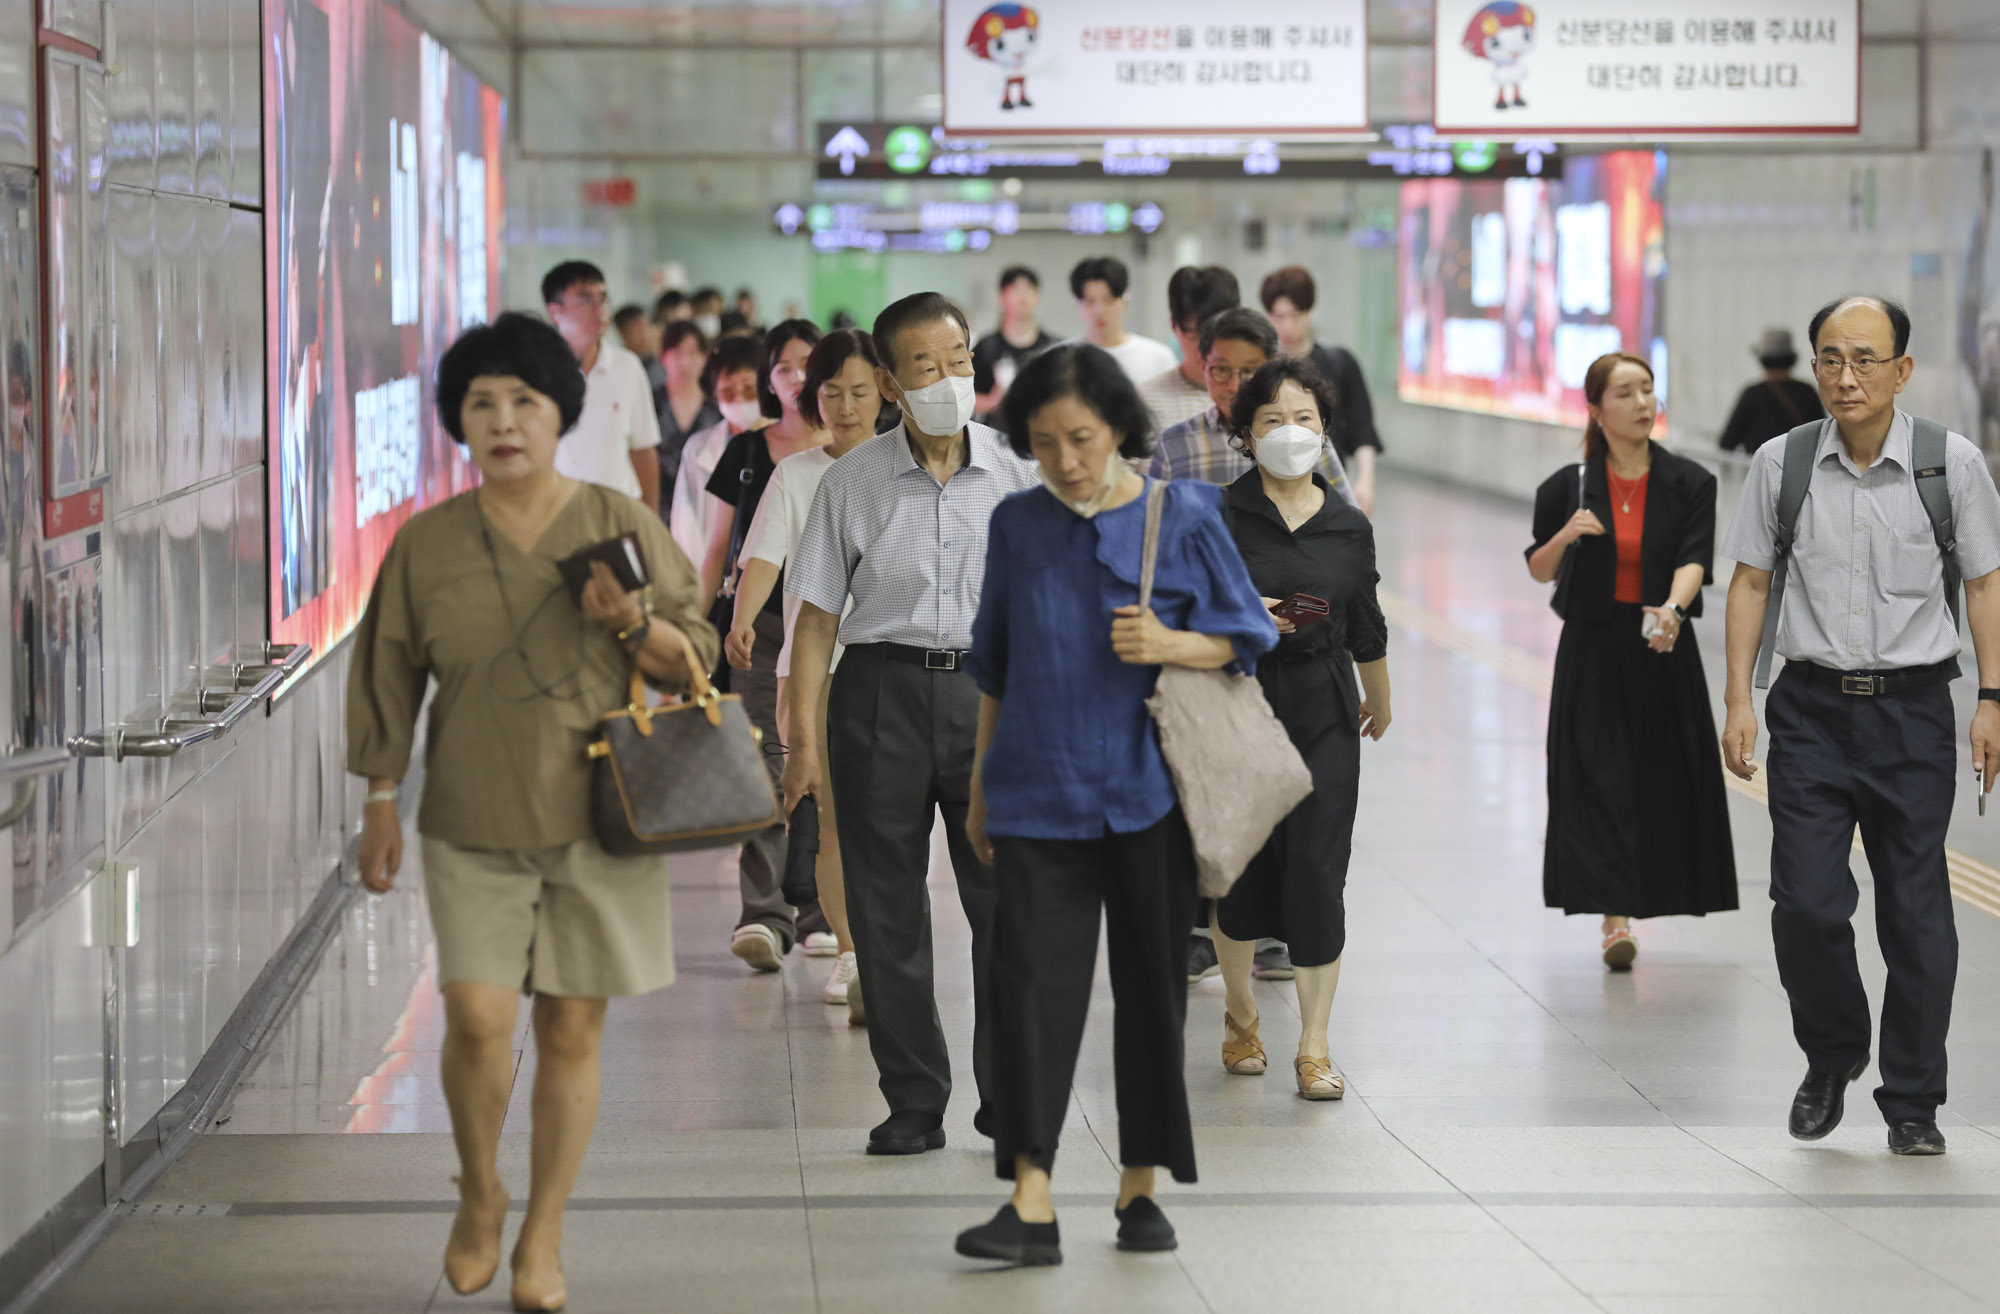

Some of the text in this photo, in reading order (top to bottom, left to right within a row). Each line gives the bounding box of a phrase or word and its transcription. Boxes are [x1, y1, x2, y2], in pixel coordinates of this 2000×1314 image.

[1081, 25, 1352, 50] 신분당선을 이용해 주셔서
[1555, 17, 1836, 46] 신분당선을 이용해 주셔서
[1116, 60, 1185, 85] 대단히
[1587, 63, 1660, 89] 대단히
[895, 132, 921, 168] 2
